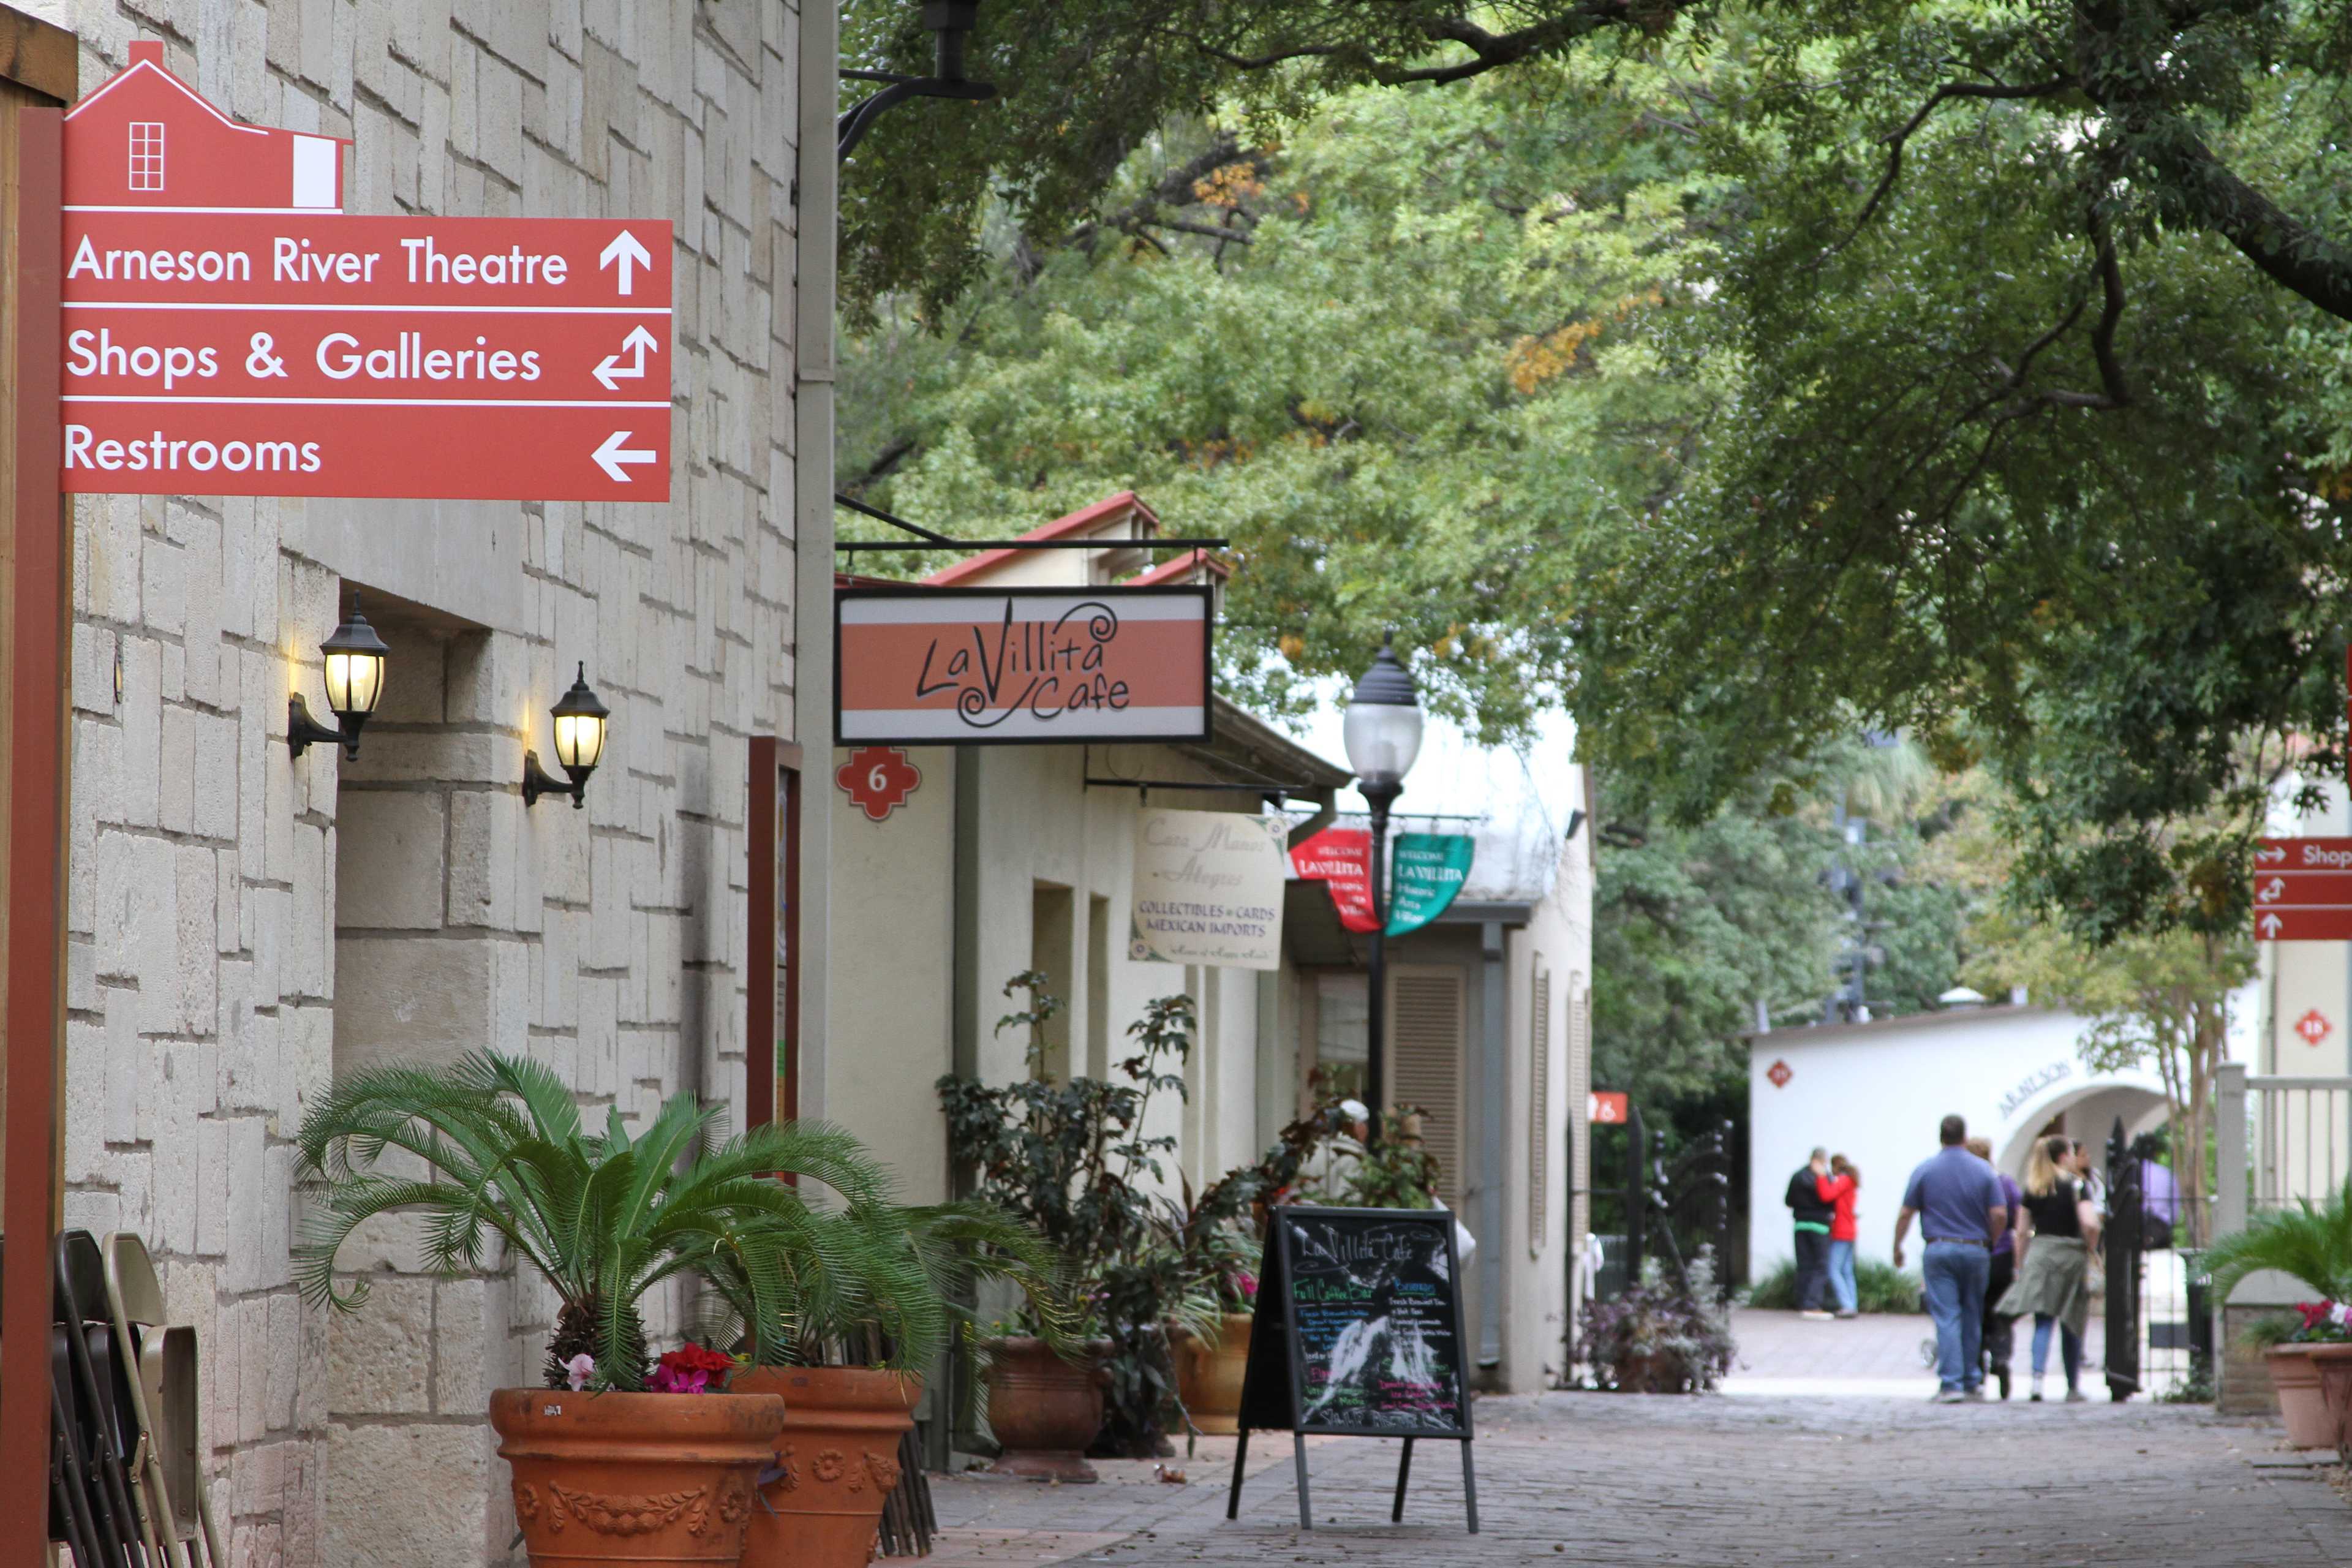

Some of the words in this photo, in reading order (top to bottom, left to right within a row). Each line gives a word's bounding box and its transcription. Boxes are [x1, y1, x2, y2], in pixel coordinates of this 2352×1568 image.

[66, 233, 251, 282] Arneson
[273, 236, 381, 284] River
[401, 236, 568, 285] Theatre
[66, 329, 218, 390] Shops
[246, 332, 288, 378] &
[316, 332, 541, 381] Galleries
[64, 424, 322, 473] Restrooms
[1031, 676, 1129, 719] Cafe
[869, 764, 887, 792] 6
[2302, 845, 2352, 869] Shop
[1139, 900, 1224, 918] COLLECTIBLES
[1236, 906, 1275, 921] CARDS
[1147, 919, 1206, 933] MEXICAN
[1210, 922, 1266, 938] IMPORTS
